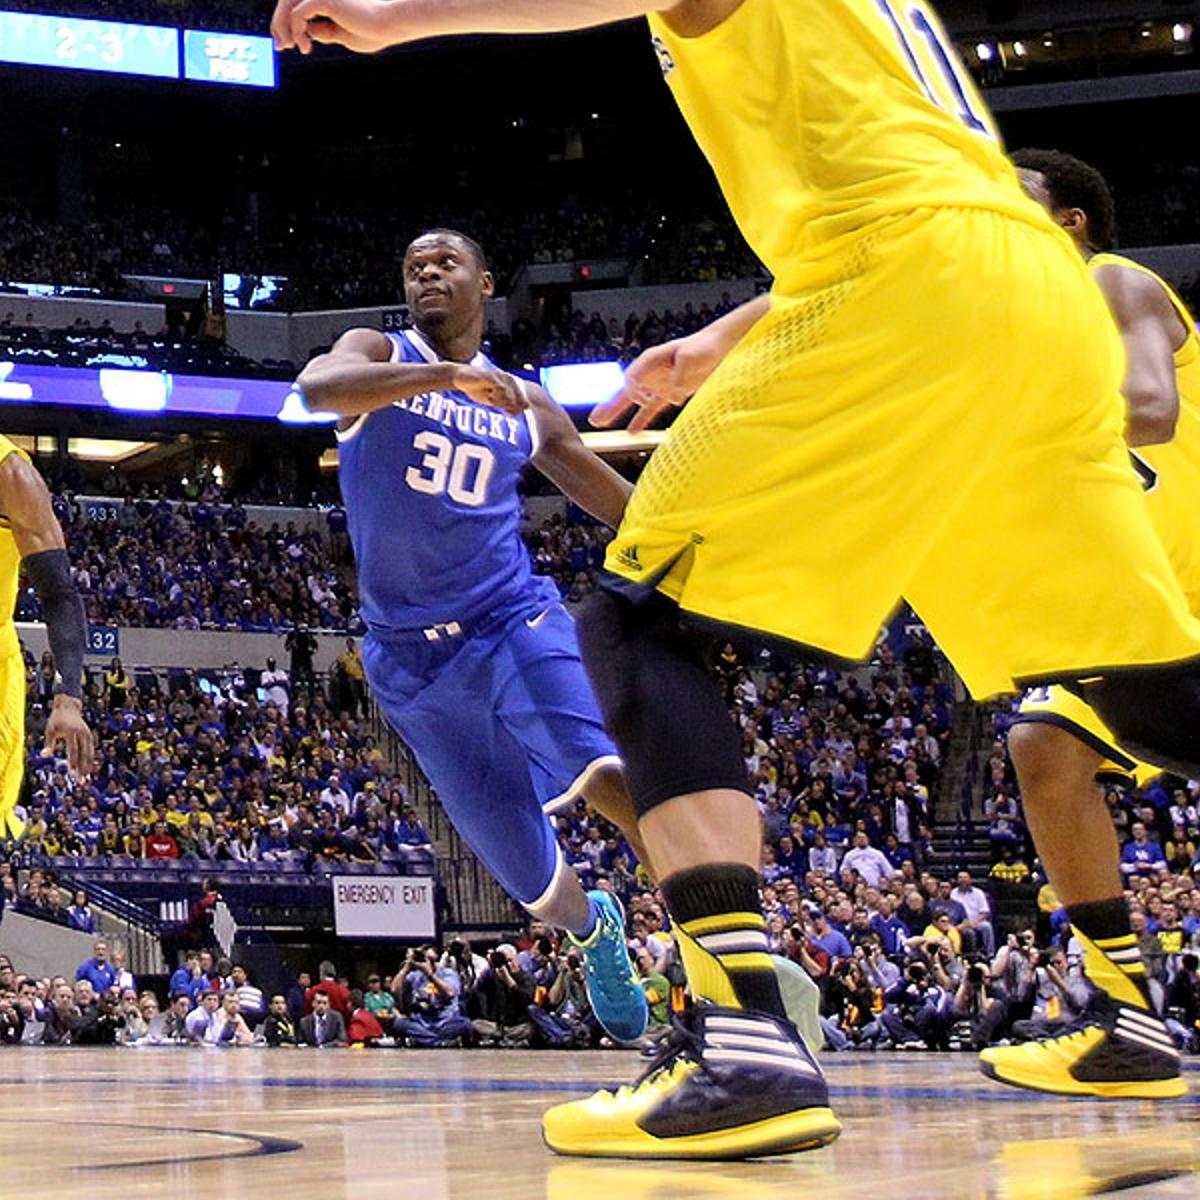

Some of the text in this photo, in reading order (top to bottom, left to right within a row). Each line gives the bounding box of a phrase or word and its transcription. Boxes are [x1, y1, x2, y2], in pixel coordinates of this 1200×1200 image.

[406, 431, 494, 507] 30
[87, 632, 116, 649] 32
[338, 883, 427, 905] EMERGENCY EXIT
